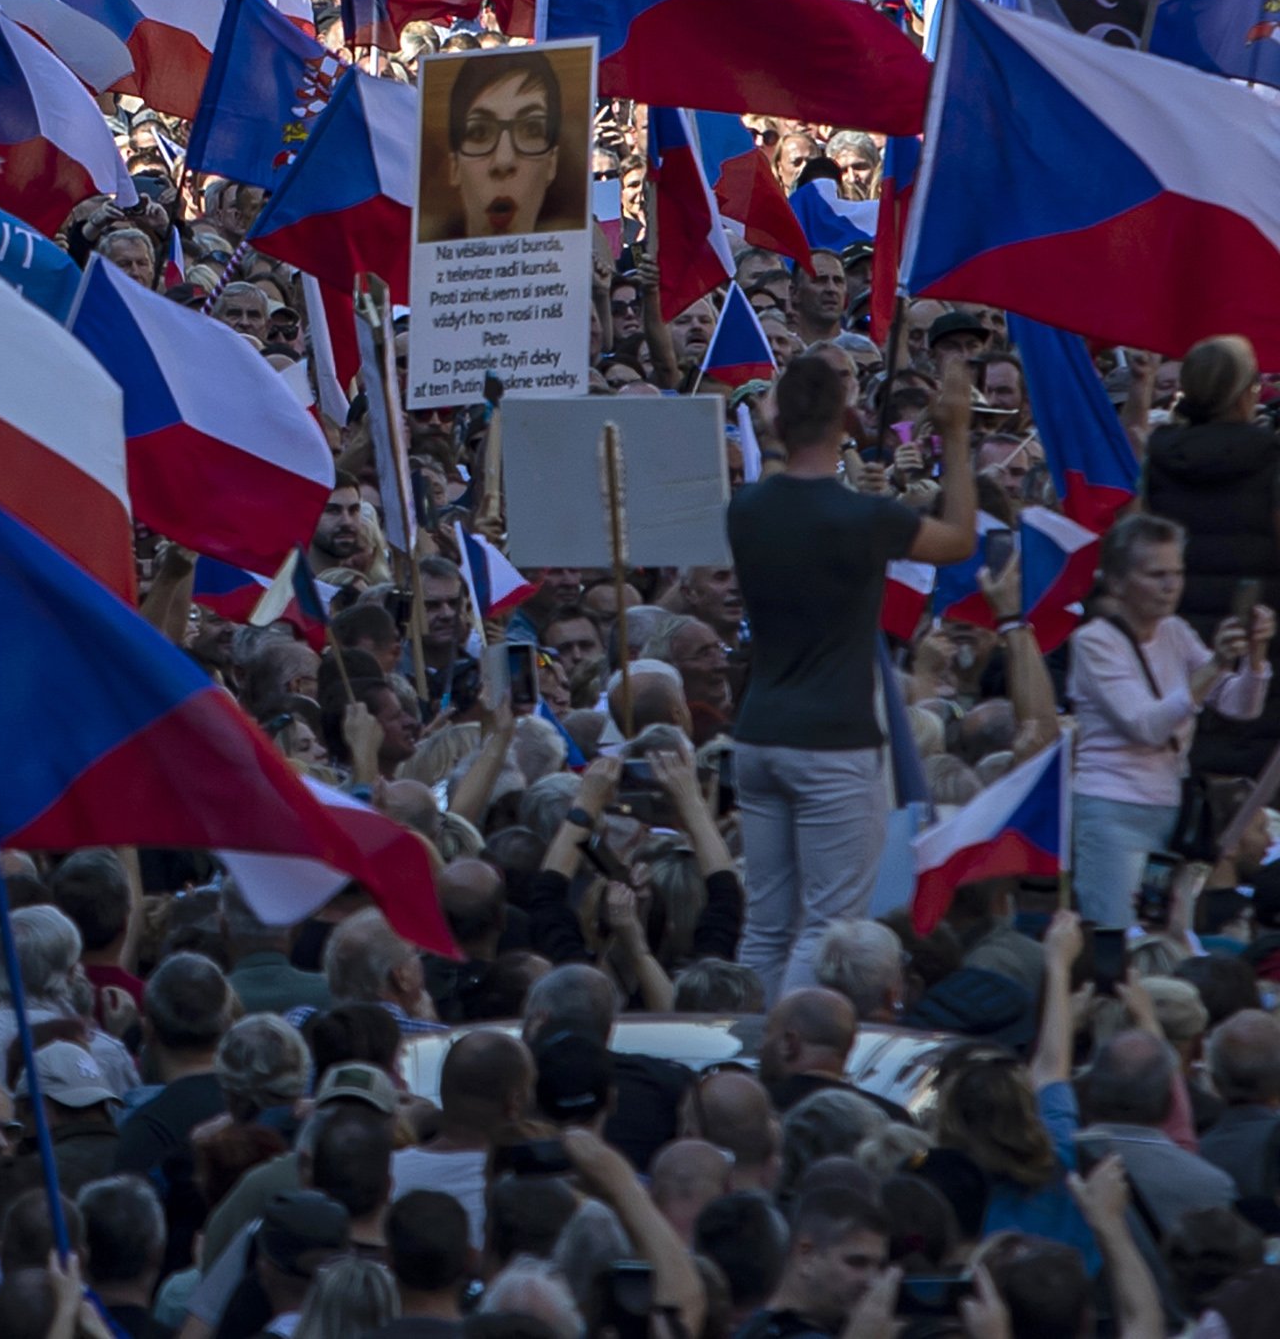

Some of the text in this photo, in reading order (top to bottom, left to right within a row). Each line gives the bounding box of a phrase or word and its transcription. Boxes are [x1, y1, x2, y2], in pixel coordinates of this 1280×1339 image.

[435, 246, 453, 261] Na
[447, 265, 492, 283] televize
[430, 289, 459, 307] Proti
[534, 281, 569, 299] svetr,
[469, 309, 486, 326] ho
[482, 331, 511, 347] Petr.
[433, 348, 562, 375] Do postele čtyři deky
[429, 381, 449, 397] ten
[451, 376, 484, 394] Putin
